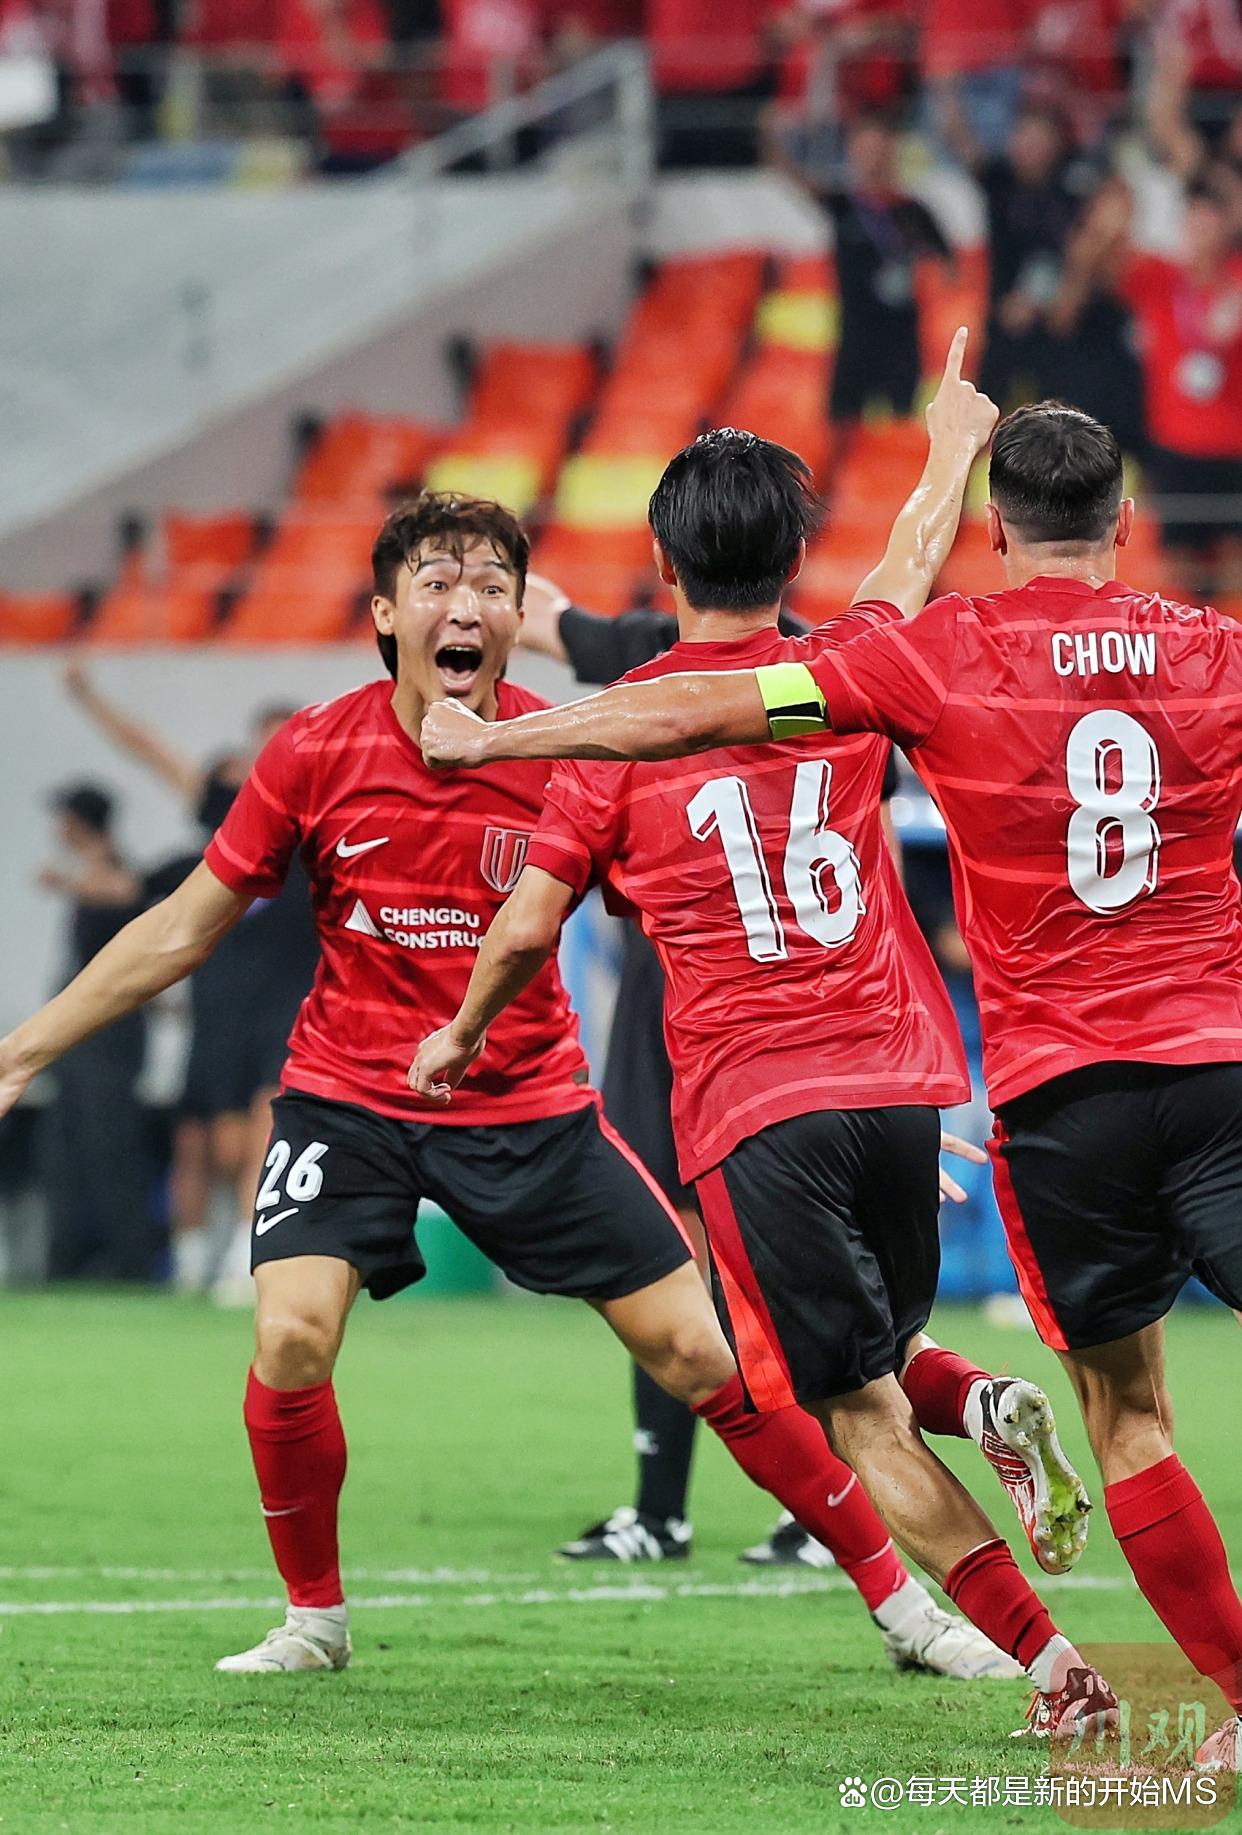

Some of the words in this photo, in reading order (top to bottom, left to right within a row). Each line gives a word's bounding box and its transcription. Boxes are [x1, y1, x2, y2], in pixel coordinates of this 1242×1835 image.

[1051, 631, 1156, 676] CHOW
[1066, 709, 1162, 914] 8
[685, 758, 866, 963] 16
[379, 906, 480, 928] CHENGDU
[256, 1139, 329, 1211] 26
